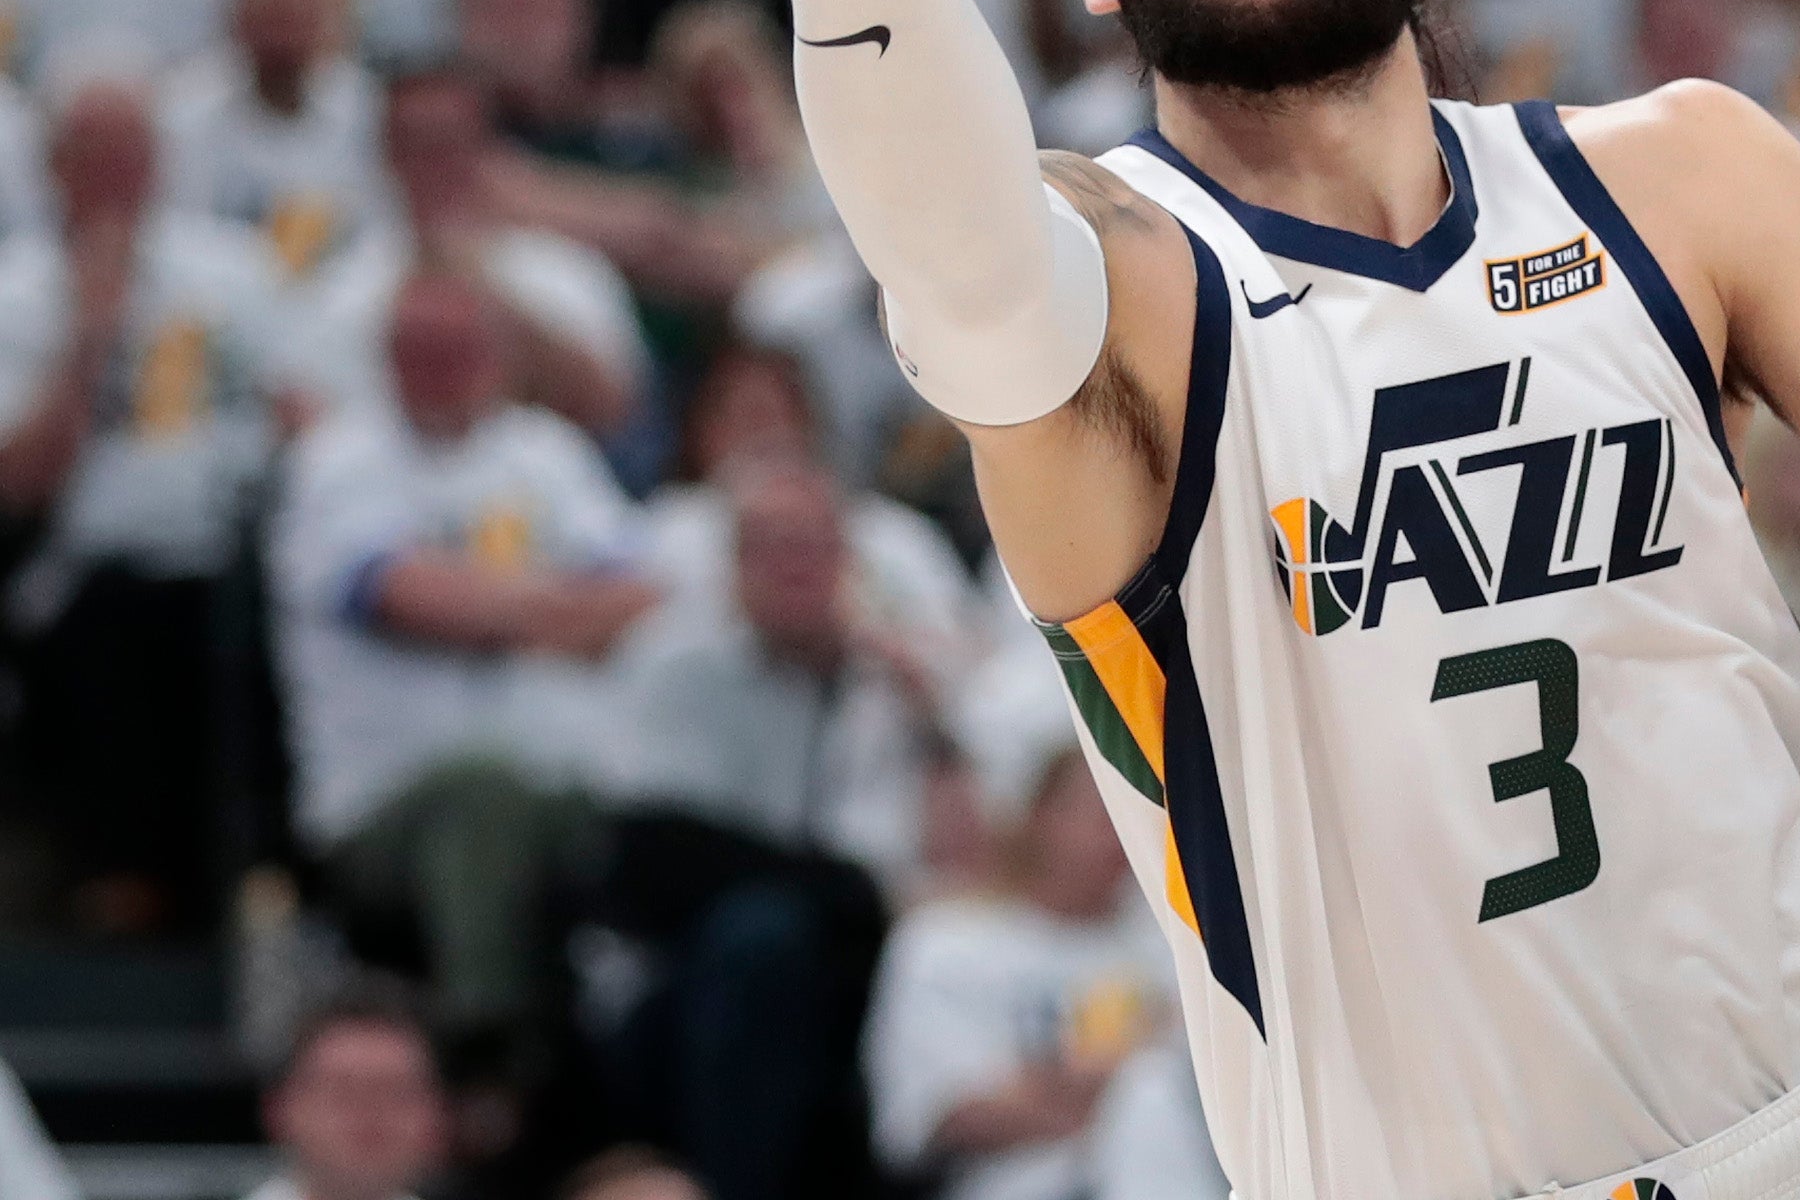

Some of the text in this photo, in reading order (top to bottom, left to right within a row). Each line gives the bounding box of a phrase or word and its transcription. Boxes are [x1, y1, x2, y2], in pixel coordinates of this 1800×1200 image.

[1527, 244, 1581, 274] FOR THE
[1491, 264, 1518, 310] 5
[1529, 261, 1597, 305] FIGHT
[1270, 356, 1685, 637] JAZZ
[1430, 637, 1601, 924] 3
